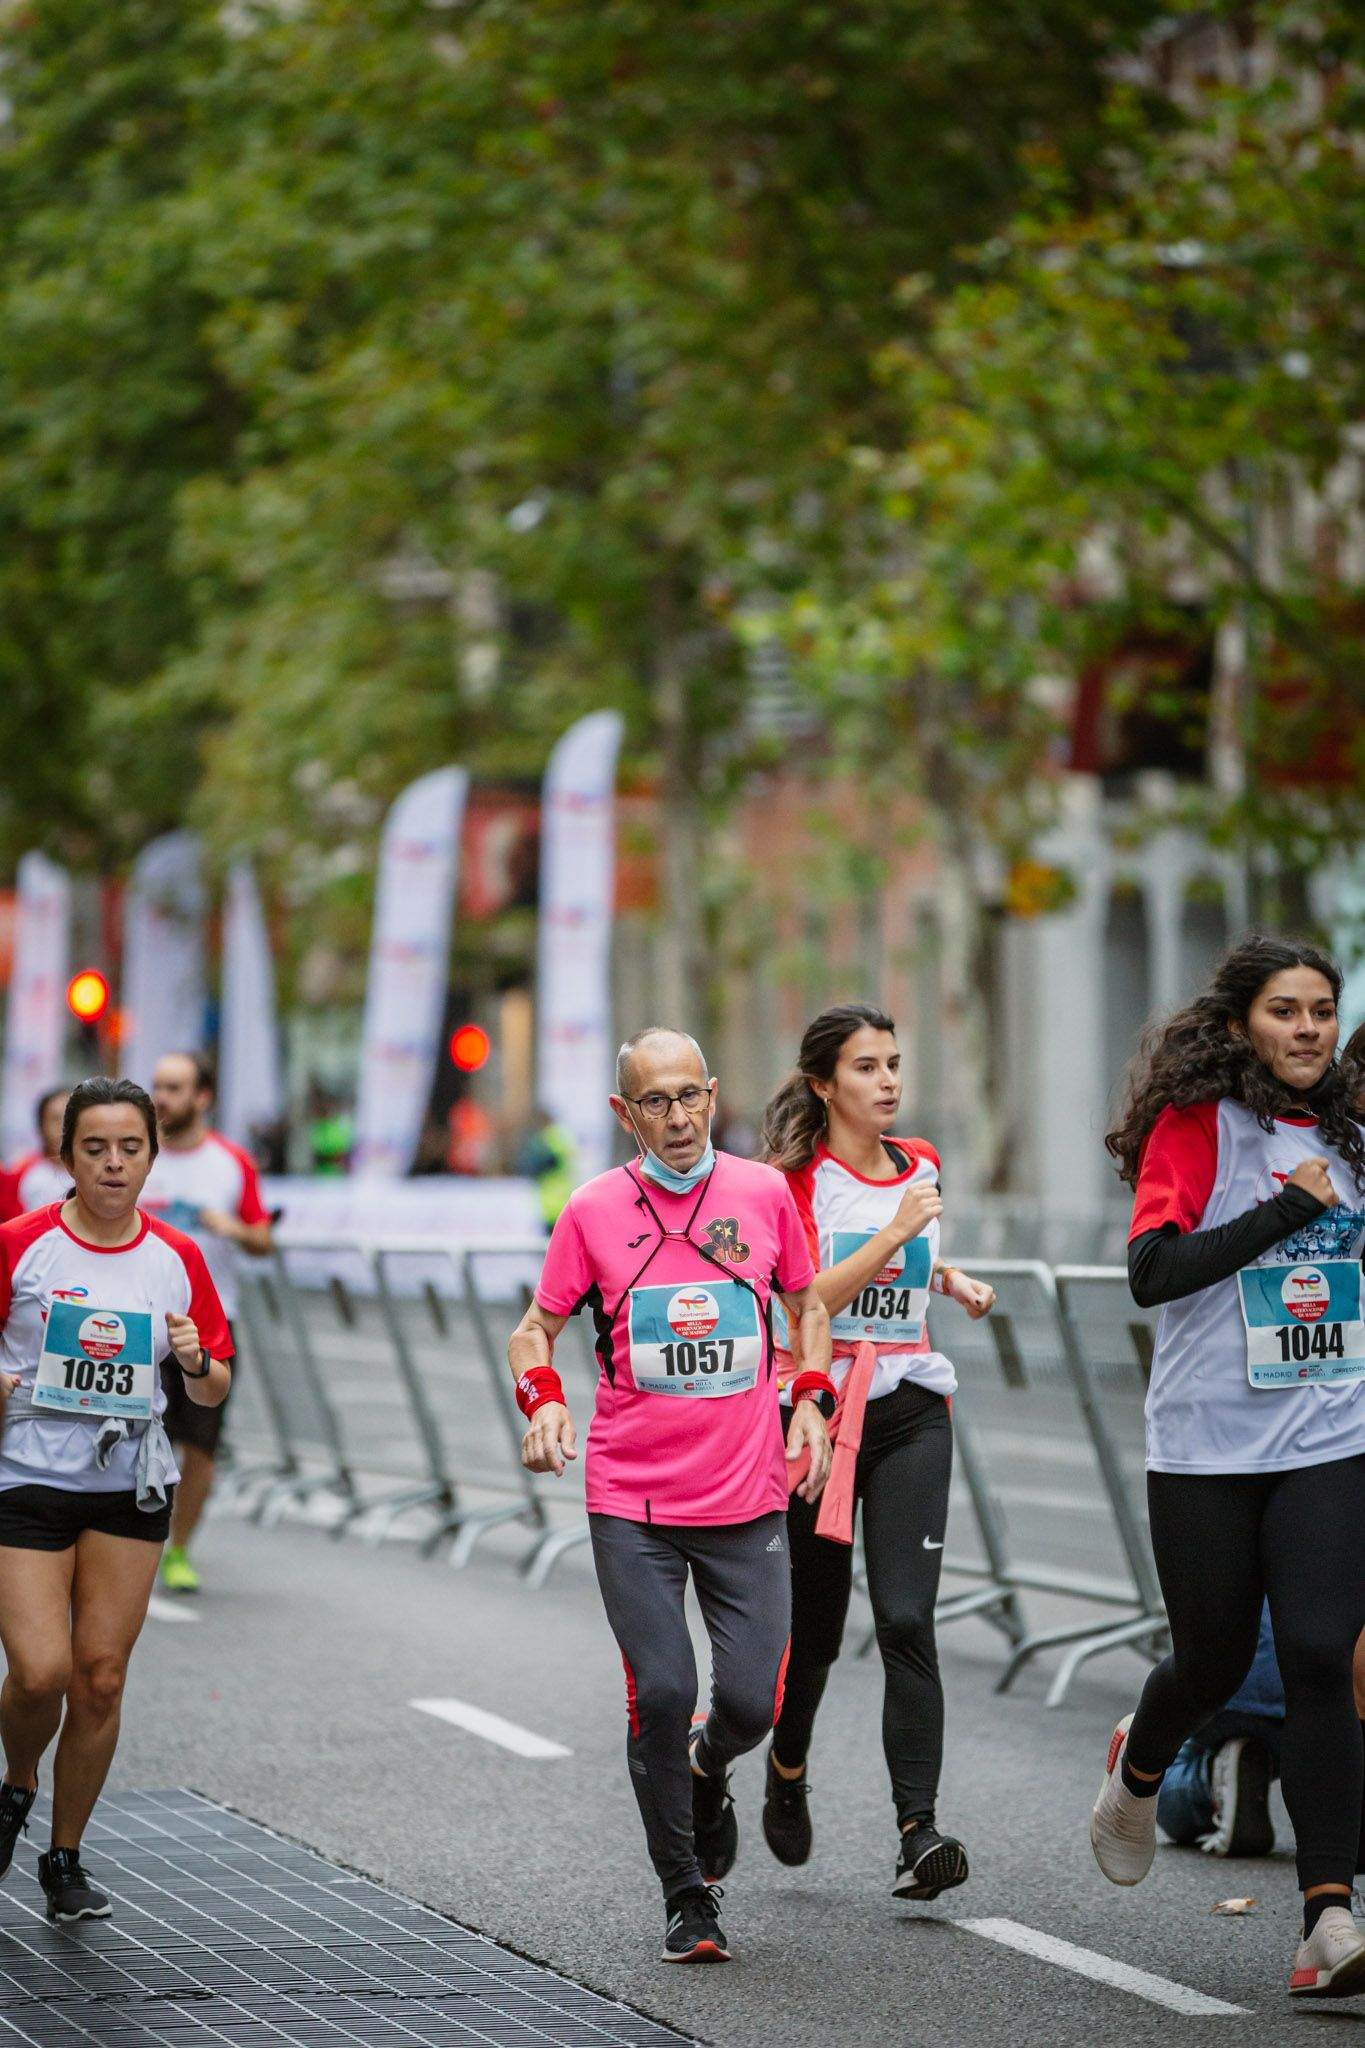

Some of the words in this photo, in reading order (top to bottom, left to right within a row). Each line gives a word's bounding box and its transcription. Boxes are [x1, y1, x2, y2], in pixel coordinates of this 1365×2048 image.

[850, 1287, 911, 1320] 1034
[660, 1339, 734, 1376] 1057
[1275, 1323, 1345, 1362] 1044
[62, 1358, 135, 1396] 1033
[1263, 1371, 1293, 1379] MADRID
